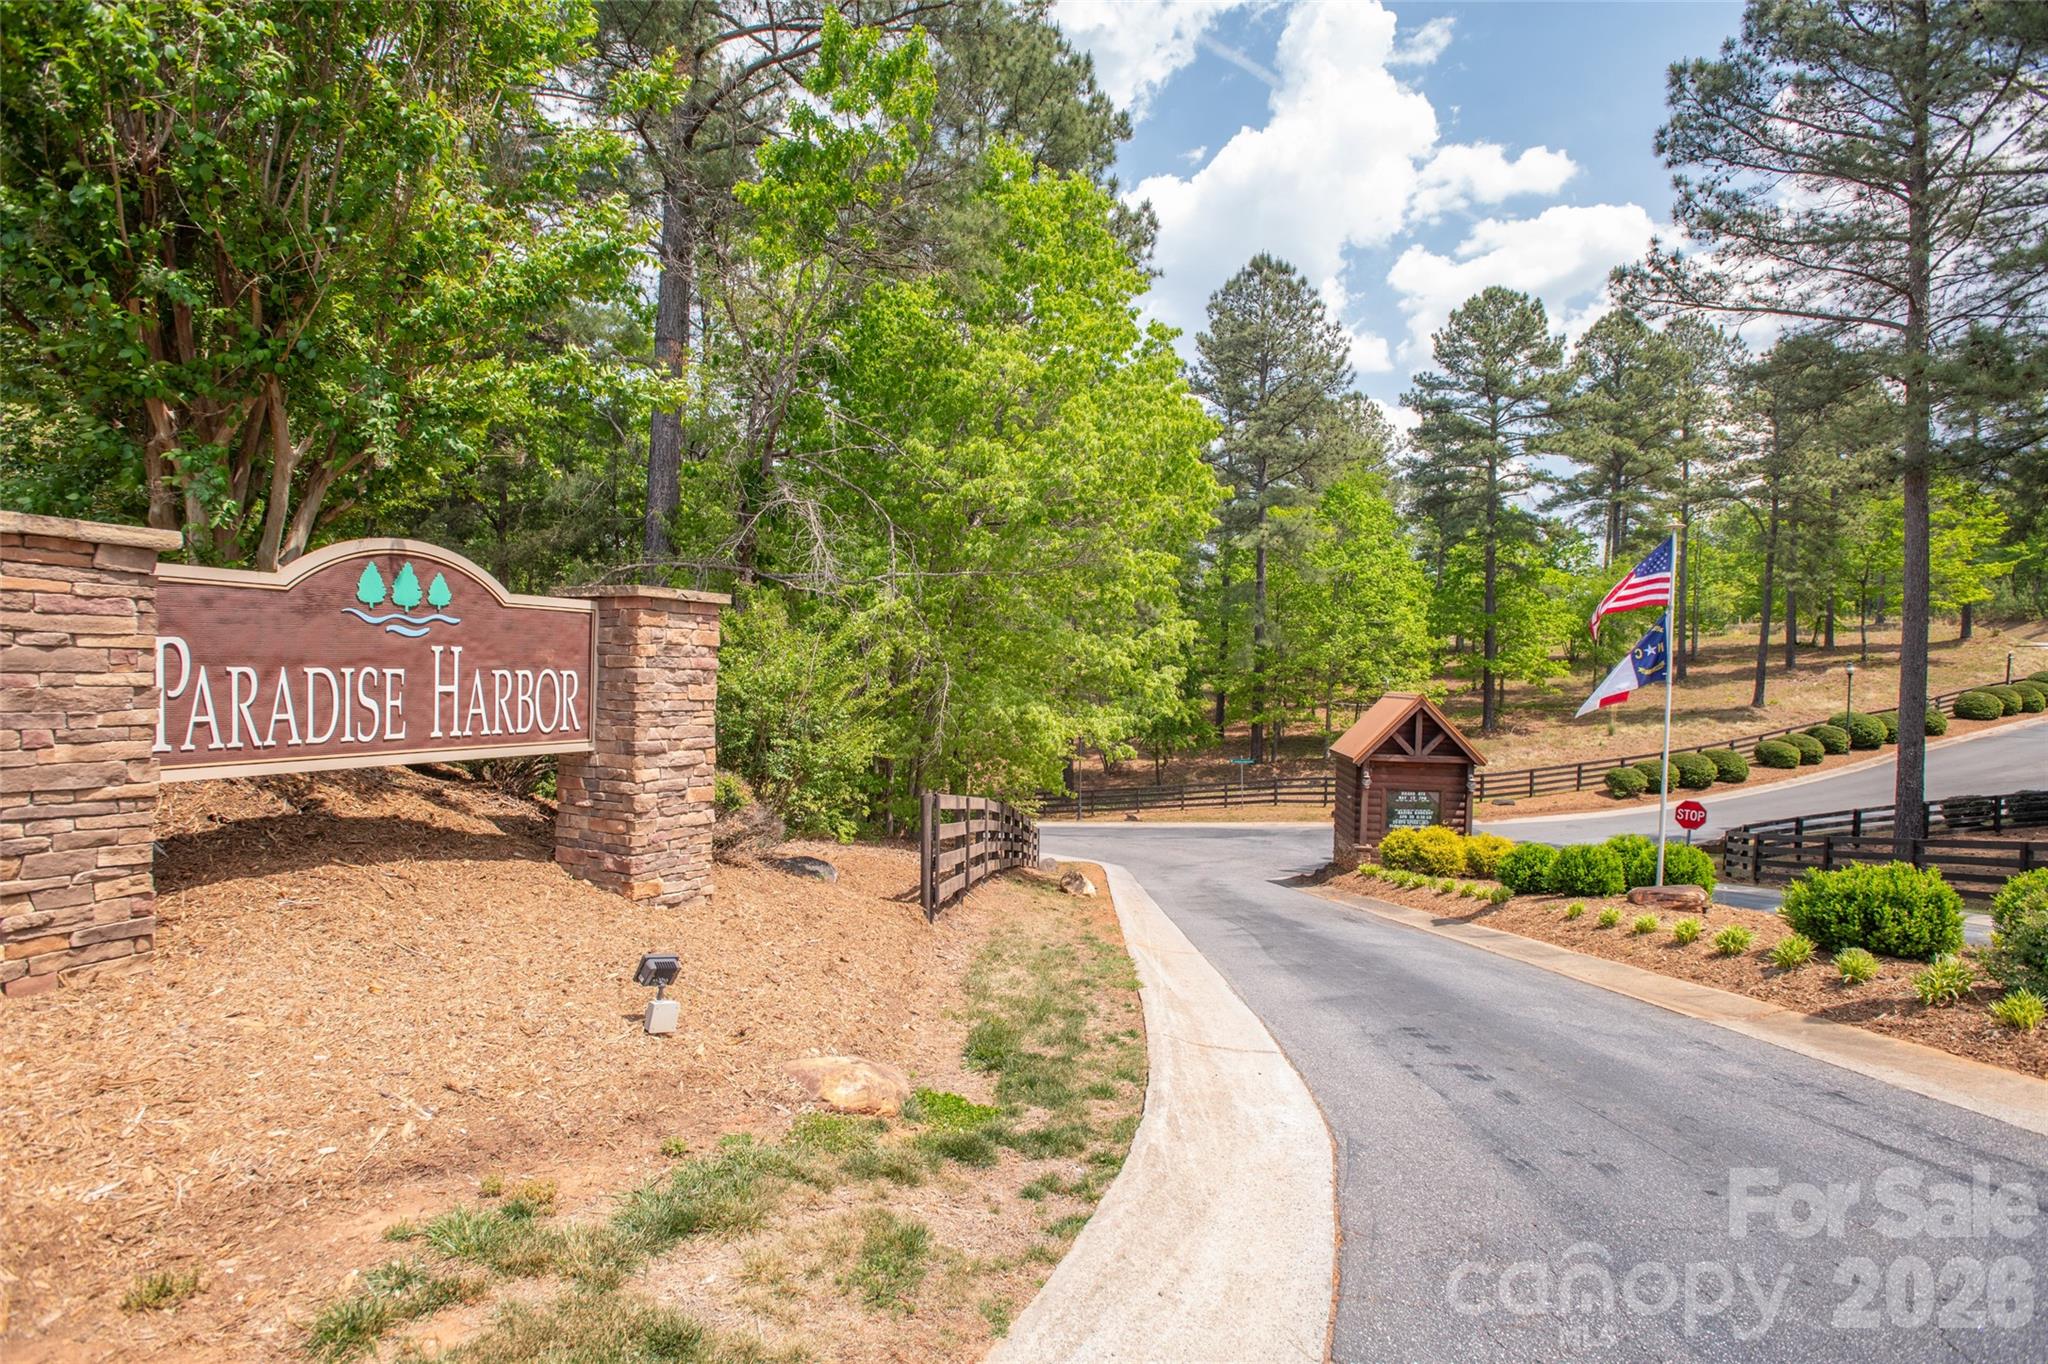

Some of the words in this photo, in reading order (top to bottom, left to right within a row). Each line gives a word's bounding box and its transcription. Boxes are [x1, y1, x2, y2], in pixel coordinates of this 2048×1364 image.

[152, 636, 407, 753] PARADISE
[430, 645, 581, 739] HARBOR
[1676, 808, 1705, 822] STOP
